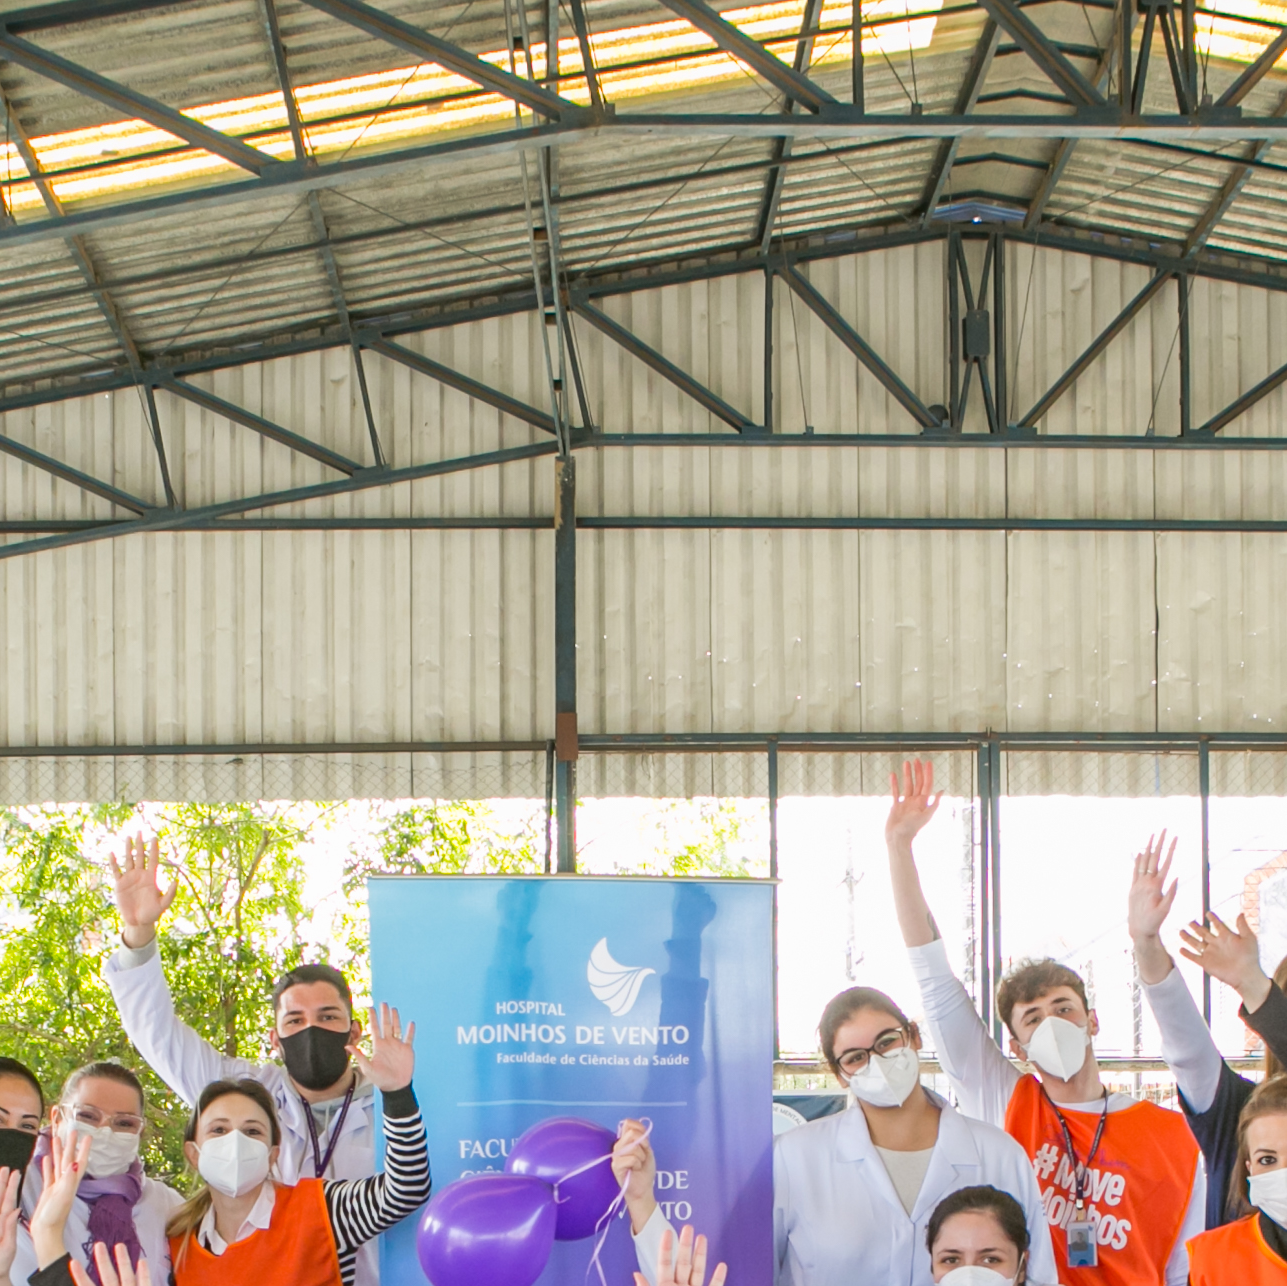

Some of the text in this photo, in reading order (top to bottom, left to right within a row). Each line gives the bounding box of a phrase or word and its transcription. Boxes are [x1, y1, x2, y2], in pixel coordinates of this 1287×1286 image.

[496, 1001, 565, 1016] HOSPITAL
[457, 1024, 689, 1045] MOINHOS DE VENTO
[497, 1052, 689, 1066] Faculdade de Ciências da Saúde
[1034, 1143, 1126, 1207] #Move
